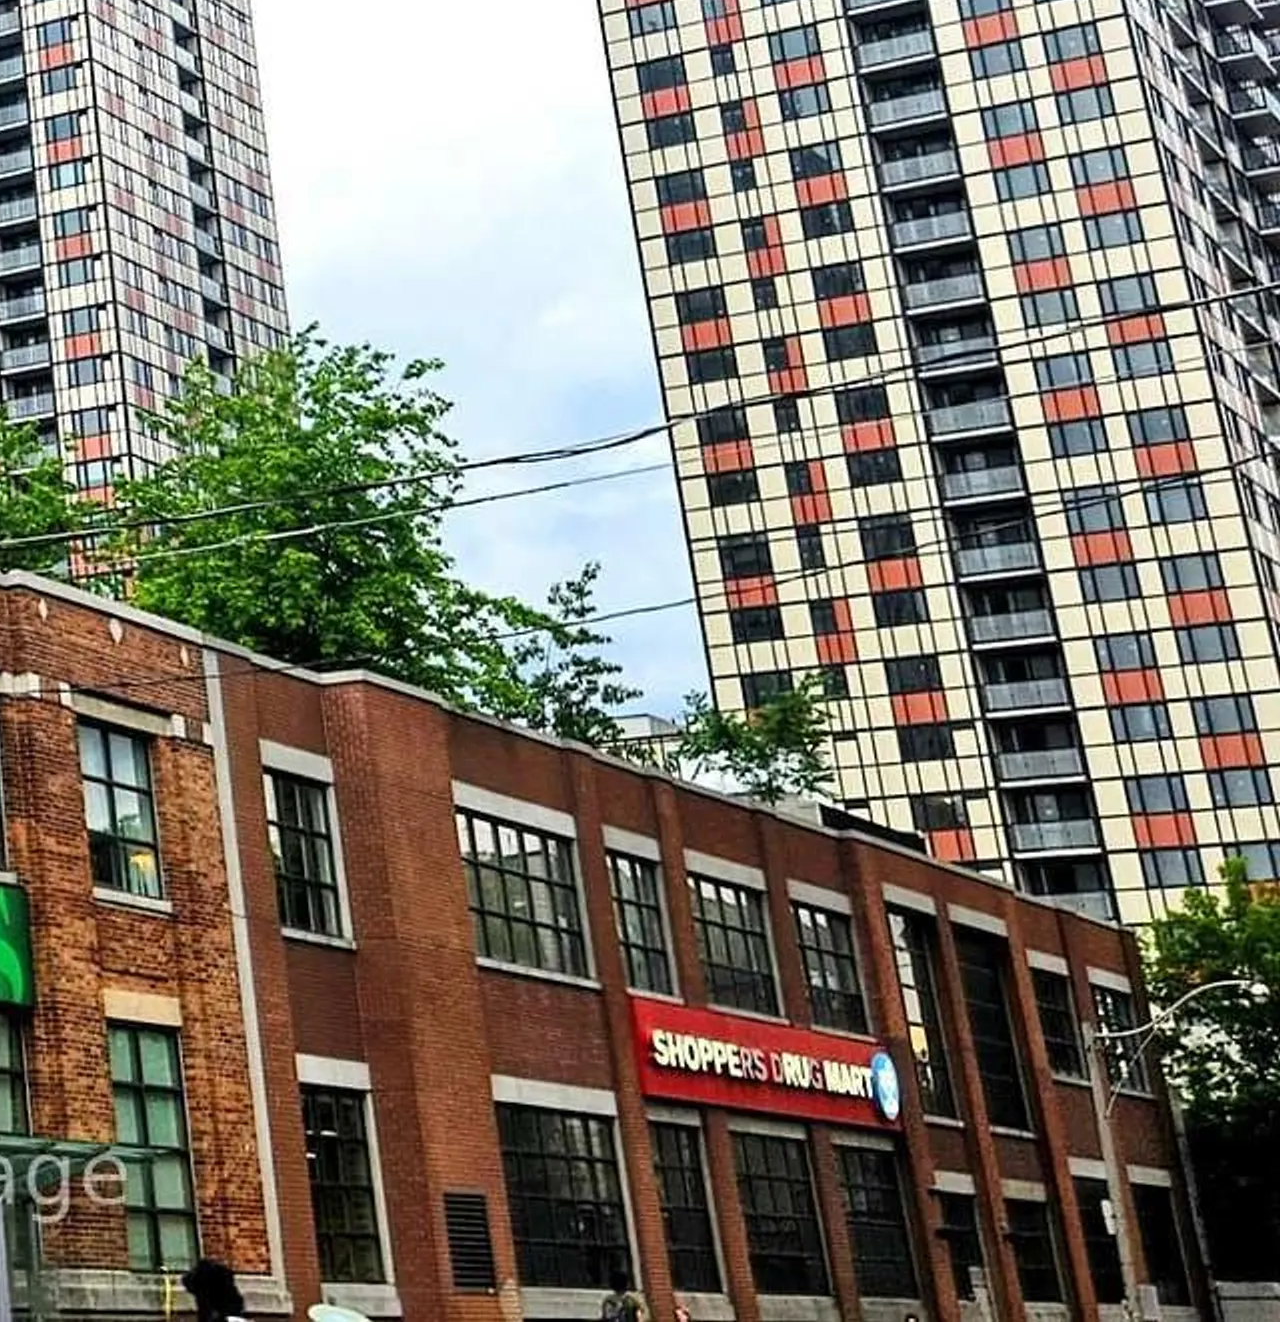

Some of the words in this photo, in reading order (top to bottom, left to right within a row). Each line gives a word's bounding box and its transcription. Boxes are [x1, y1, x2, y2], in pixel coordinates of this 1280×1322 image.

[651, 1029, 769, 1081] SHOPPERS
[770, 1052, 823, 1090] DRUG
[823, 1059, 874, 1099] MART
